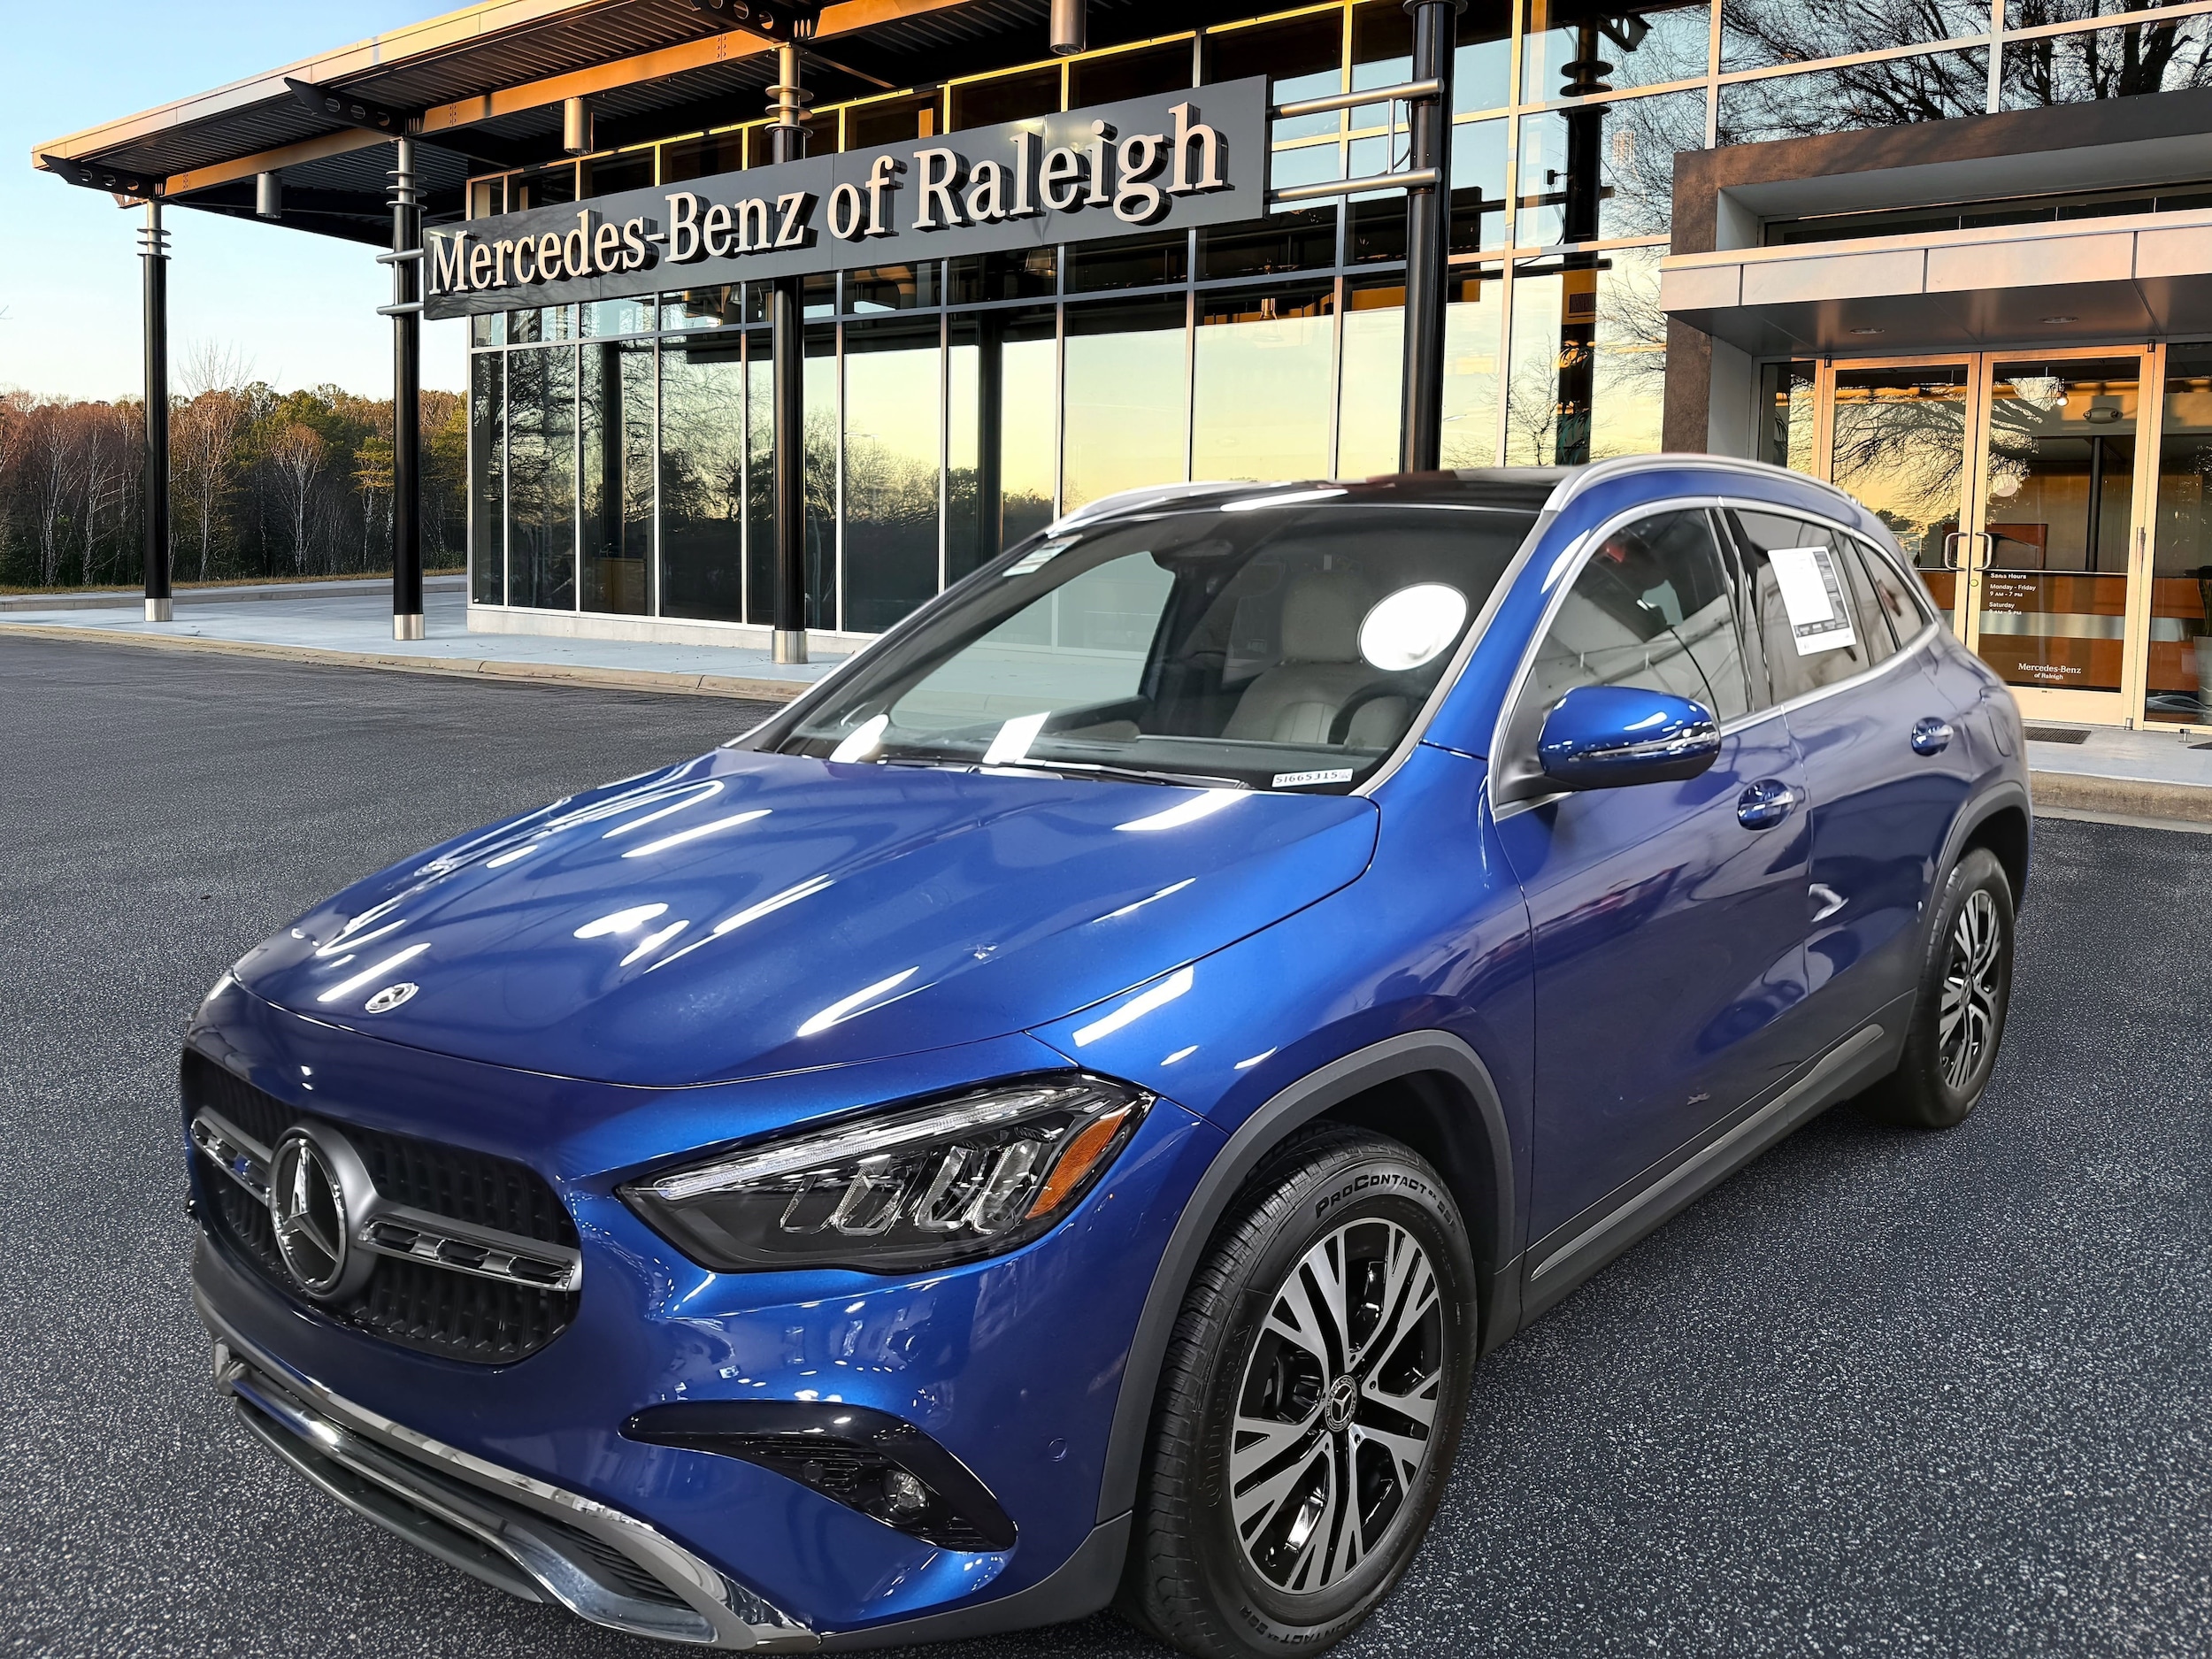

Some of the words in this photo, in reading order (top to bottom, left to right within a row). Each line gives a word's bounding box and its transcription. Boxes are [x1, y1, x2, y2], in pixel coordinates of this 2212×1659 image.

[429, 190, 807, 296] Mercedes-Benz
[826, 154, 895, 240] of
[911, 101, 1225, 228] Raleigh
[2017, 663, 2082, 674] Mercedes-Benz
